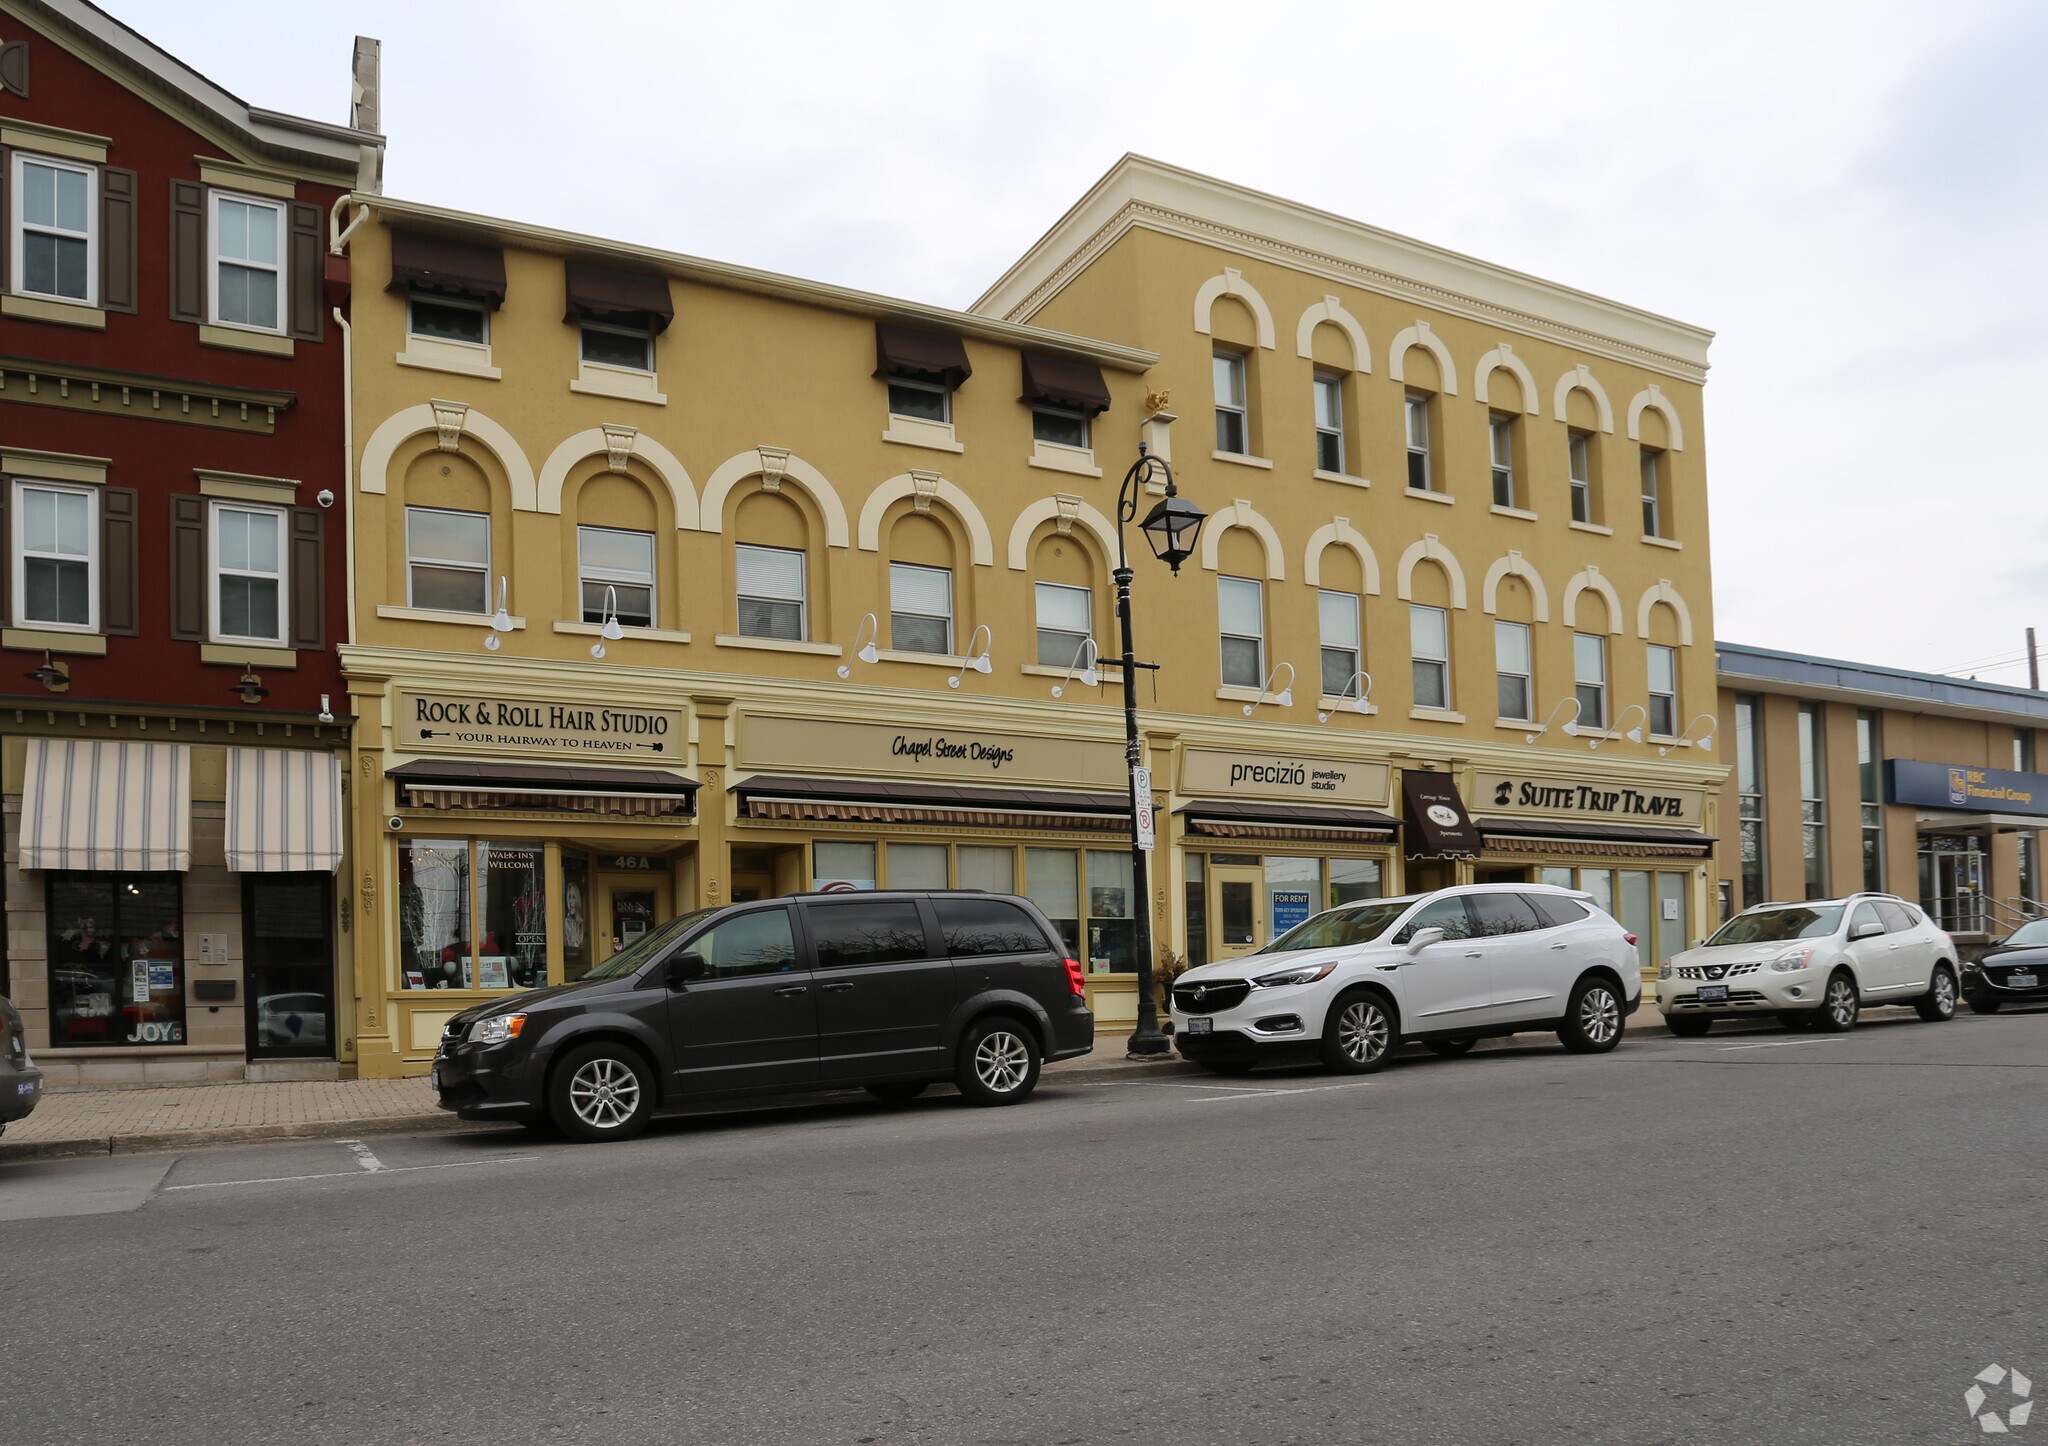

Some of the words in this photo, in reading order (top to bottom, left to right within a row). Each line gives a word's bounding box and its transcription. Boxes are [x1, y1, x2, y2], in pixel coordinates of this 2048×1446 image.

[416, 698, 470, 724] ROCK
[476, 702, 492, 726] &
[497, 703, 543, 729] ROLL
[549, 707, 596, 731] HAIR
[601, 710, 669, 735] STUDIO
[455, 732, 495, 744] YOUR
[497, 734, 558, 747] HAIRWAY
[561, 738, 579, 748] TO
[583, 739, 633, 751] HEAVEN
[893, 735, 932, 763] Chapel
[935, 737, 968, 760] Street
[971, 742, 1013, 768] Designs
[1230, 761, 1305, 787] precizió
[1311, 769, 1347, 782] jewellery
[1966, 771, 1986, 783] RBC
[1311, 781, 1336, 791] studio
[1519, 781, 1573, 810] SUITE
[1576, 784, 1619, 813] TRIP
[1620, 789, 1684, 818] TRAVEL
[1951, 793, 1965, 801] RBC
[1967, 785, 2006, 799] Financial
[2006, 789, 2032, 805] Group
[488, 851, 534, 859] WALK-INS
[489, 861, 535, 869] WELCOME
[1290, 895, 1308, 903] RENT
[518, 934, 544, 943] OPEN
[127, 1022, 173, 1042] JOY
